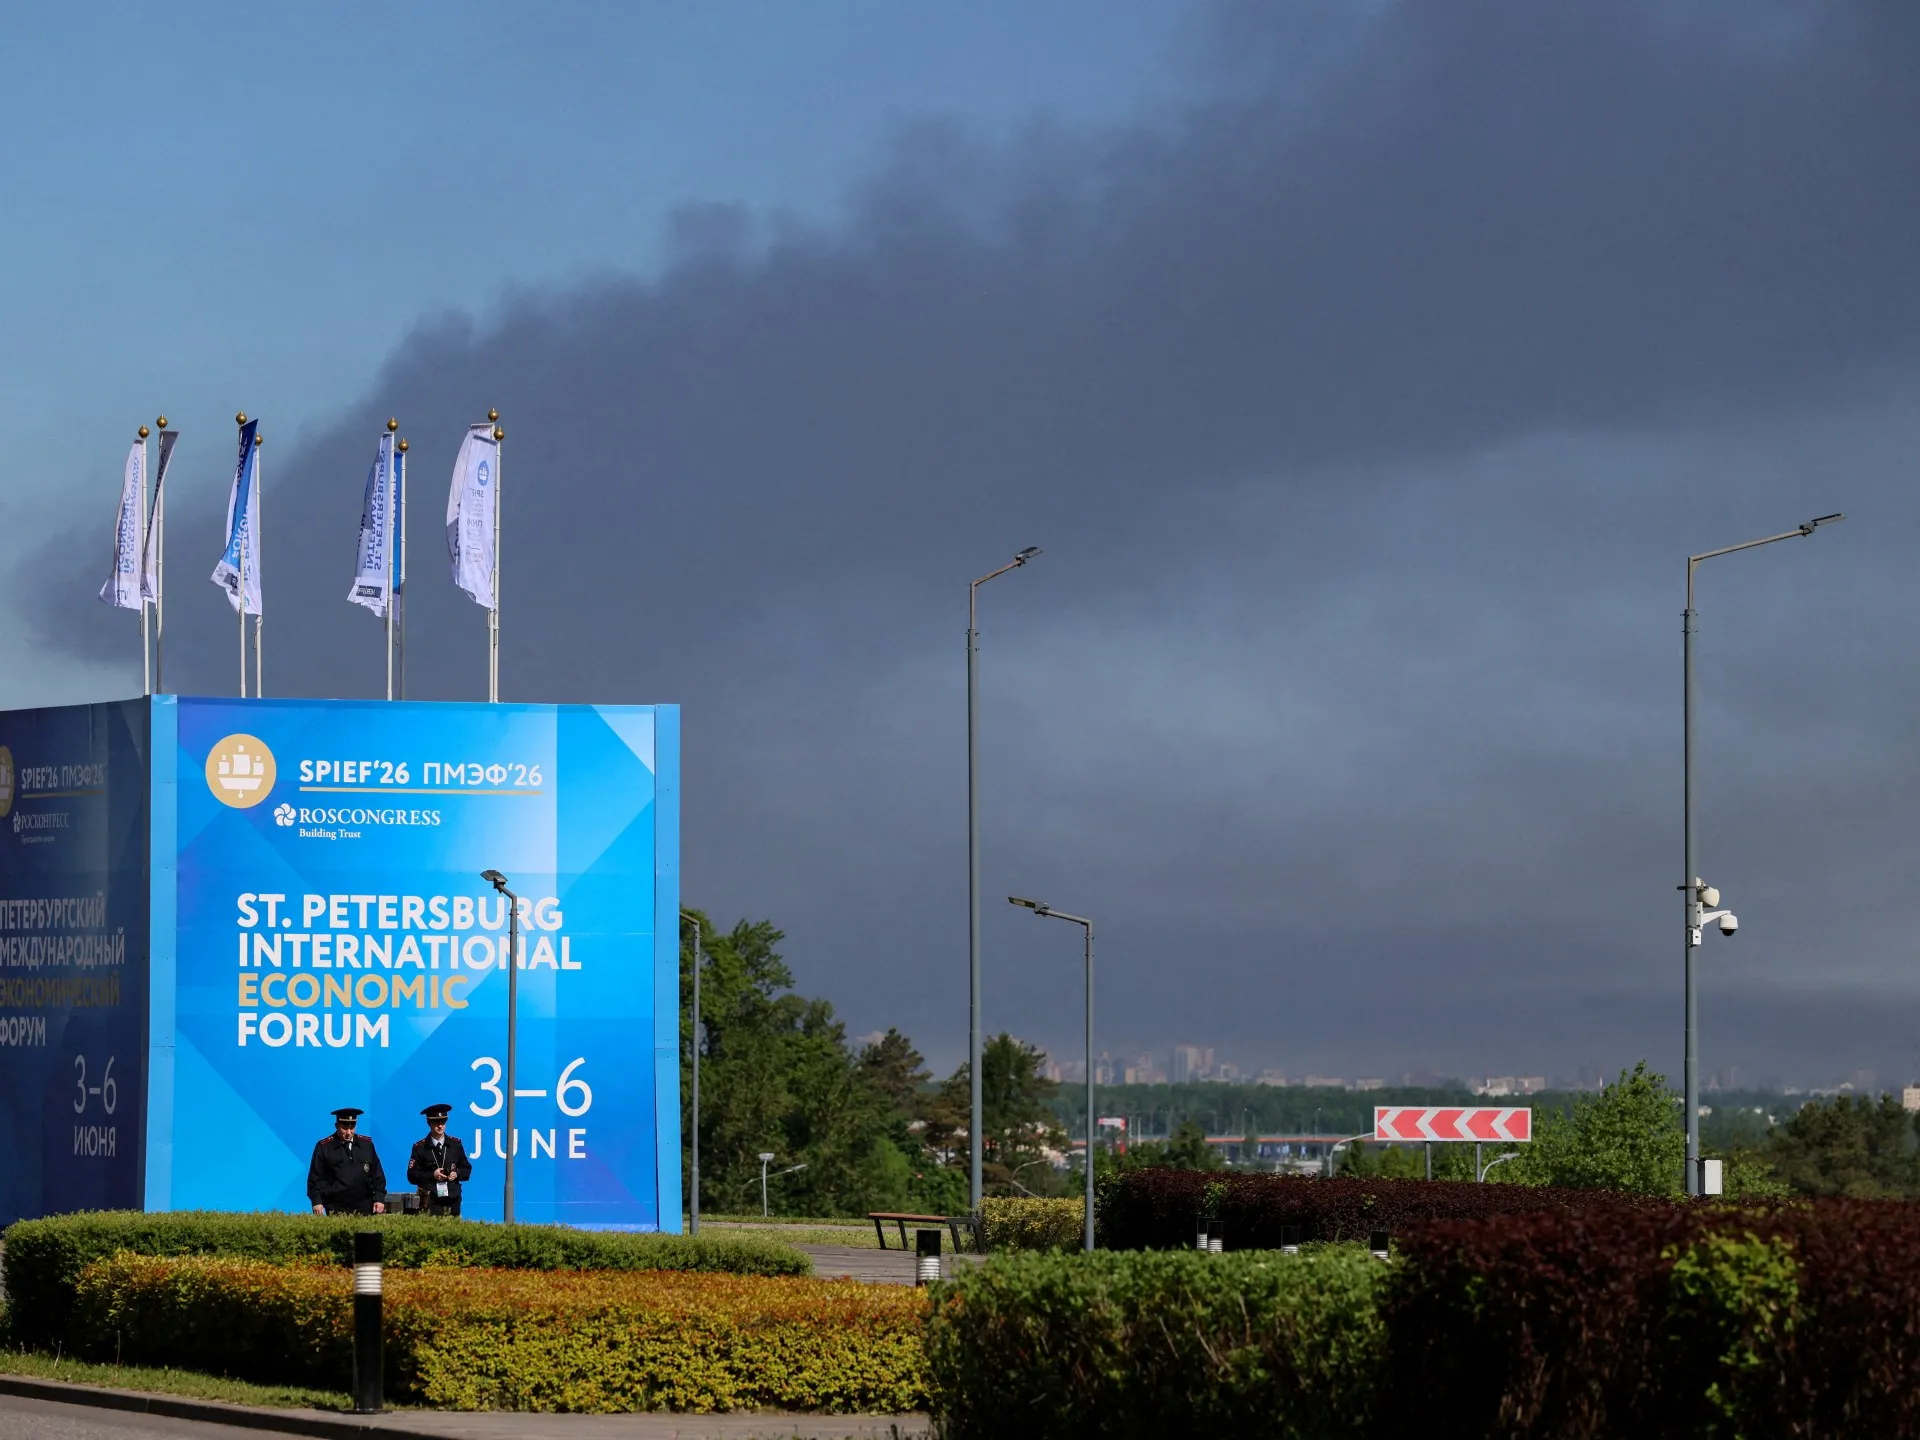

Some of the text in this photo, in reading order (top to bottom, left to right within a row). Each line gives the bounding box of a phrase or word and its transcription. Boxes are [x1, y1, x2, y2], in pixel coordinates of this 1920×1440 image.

[21, 763, 104, 789] SPIEF'26 ПМЭФ'26
[299, 760, 543, 786] SPIEF'26 ПМЭФ'26
[21, 813, 70, 829] РОСКОНГРЕСС
[298, 808, 441, 826] ROSCONGRESS
[299, 828, 361, 841] Building Trust
[0, 889, 105, 930] ПЕТЕРБУРГСКИЙ
[237, 893, 563, 931] ST. PETERSBURG
[0, 927, 125, 971] МЕЖДУНАРОДНЫЙ
[238, 933, 582, 970] INTERNATIONAL
[238, 973, 469, 1009] ECONOMIC
[0, 1016, 46, 1046] ФОРУМ
[238, 1012, 390, 1048] FORUM
[74, 1125, 116, 1158] ИЮНЯ
[469, 1128, 587, 1160] JUNE
